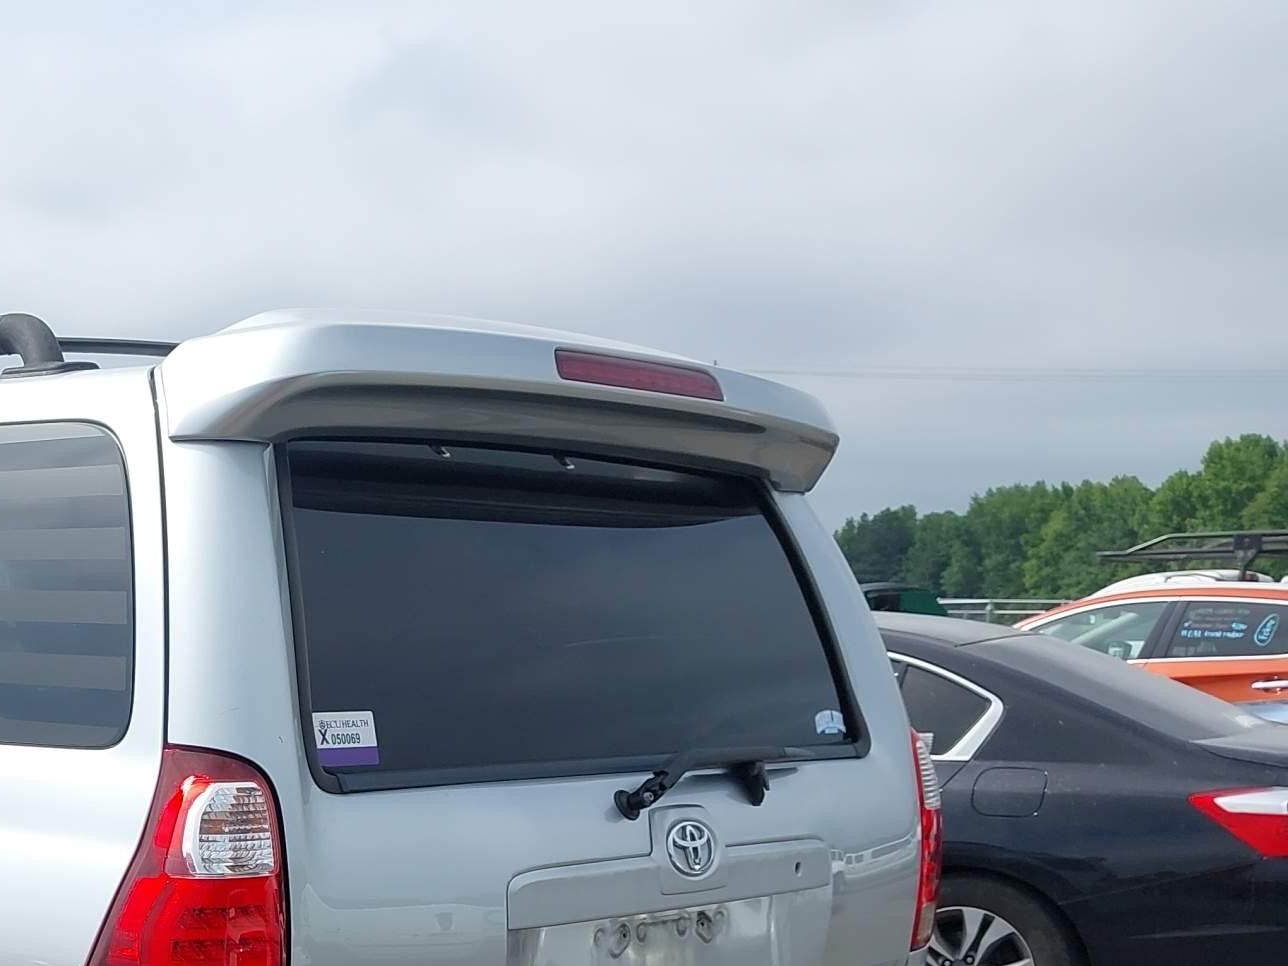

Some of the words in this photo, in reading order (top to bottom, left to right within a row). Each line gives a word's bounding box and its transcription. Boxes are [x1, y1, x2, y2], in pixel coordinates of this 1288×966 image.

[342, 719, 369, 728] HEALTH
[318, 729, 330, 745] X
[331, 733, 361, 745] 050069
